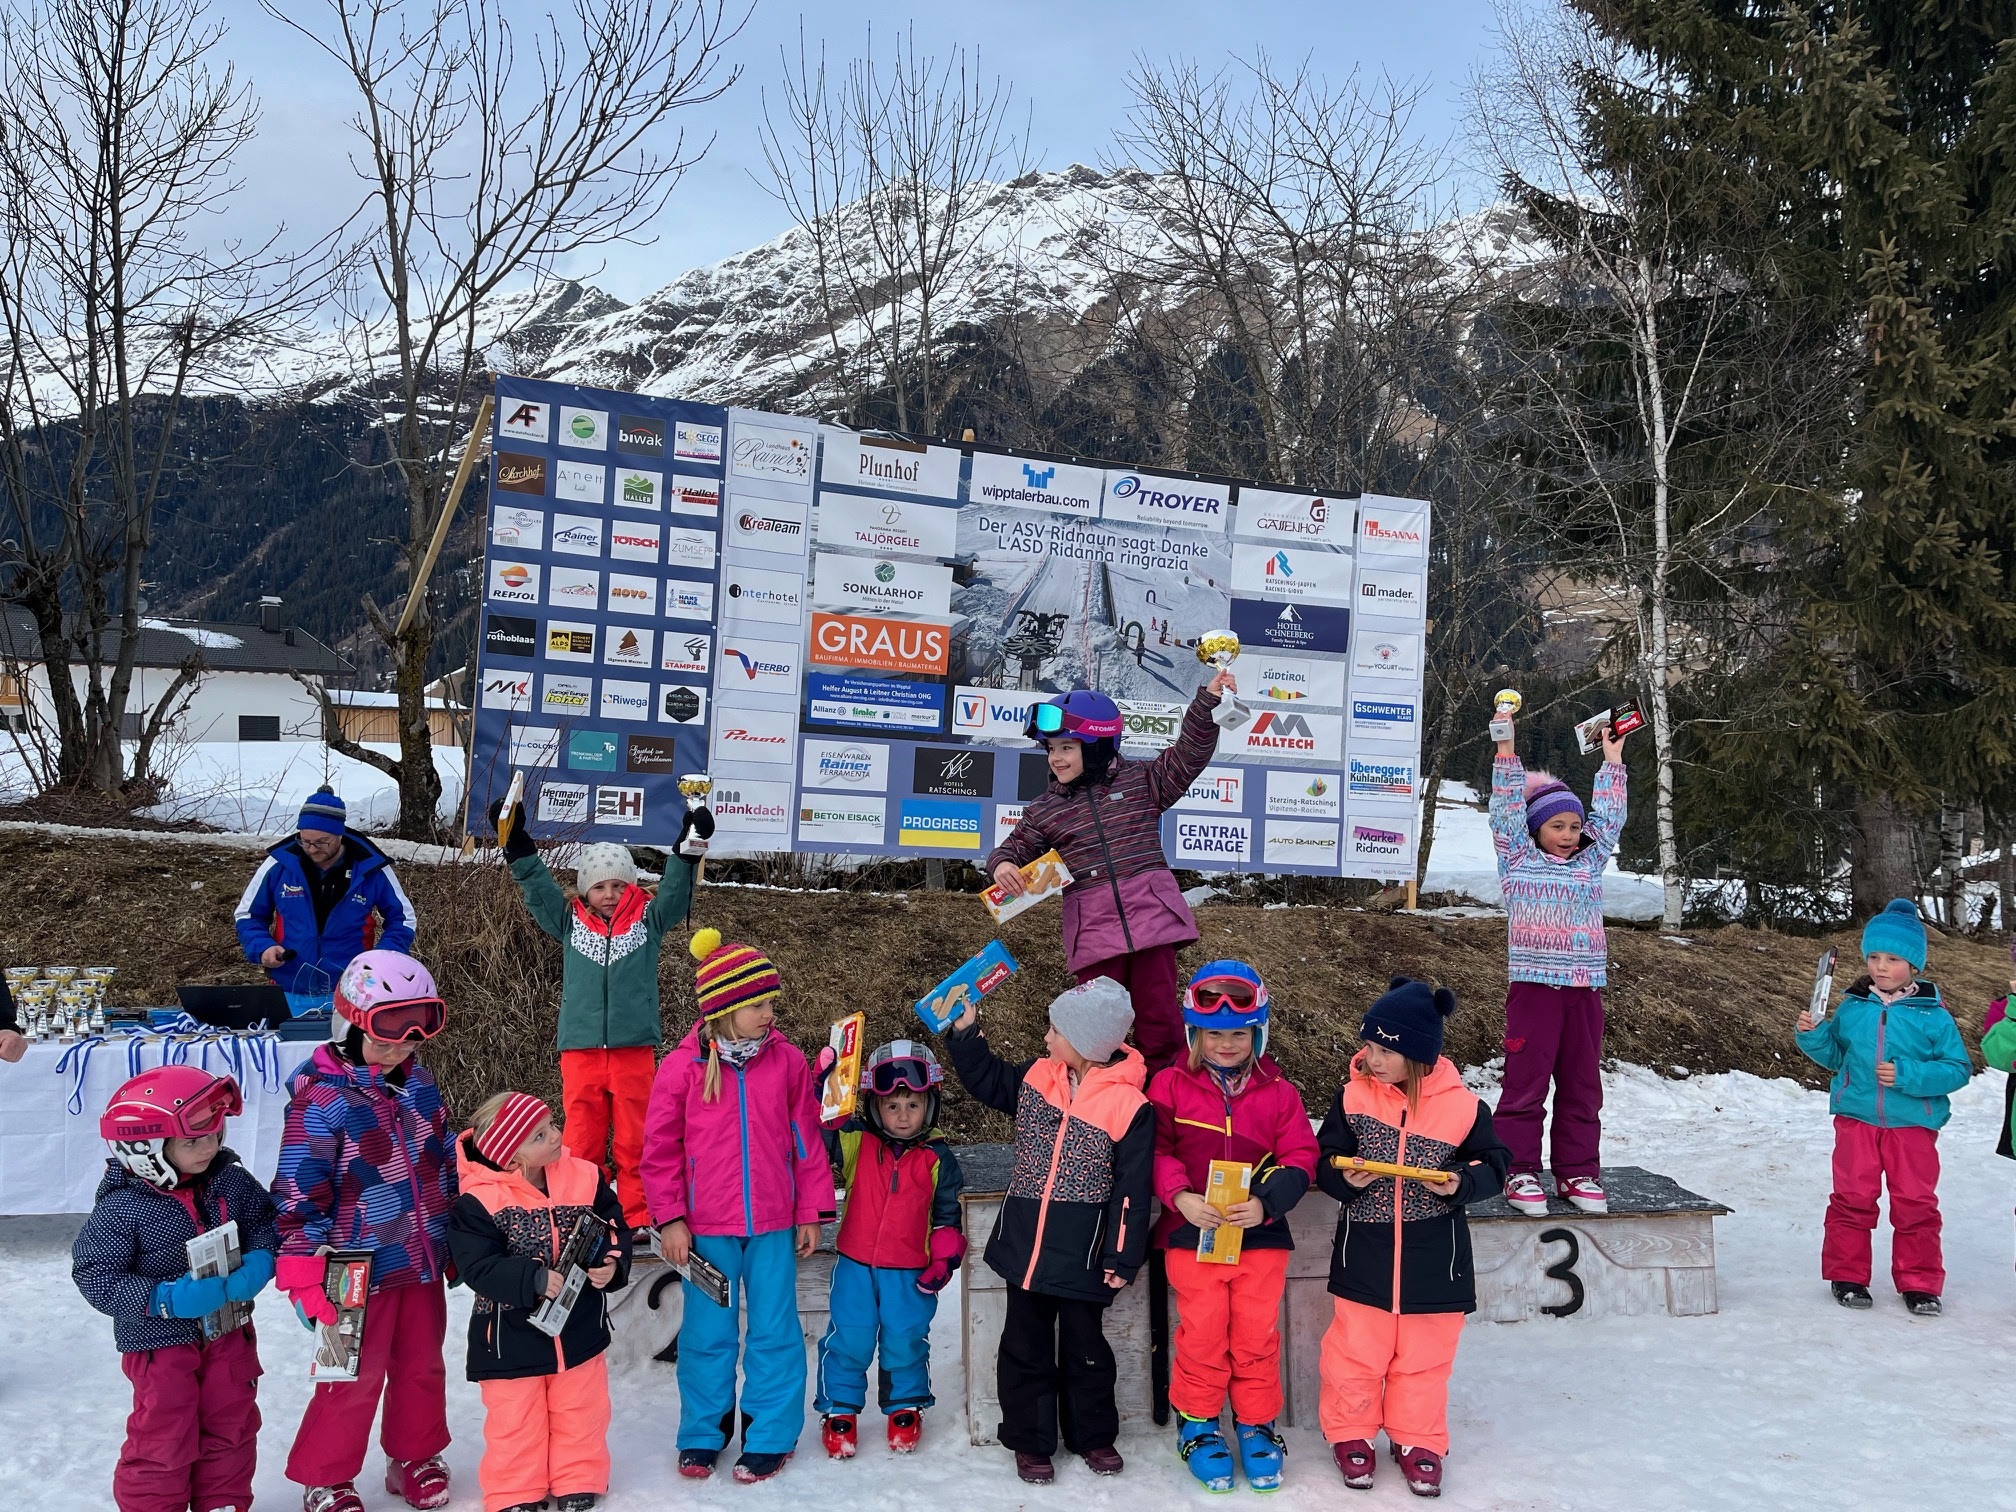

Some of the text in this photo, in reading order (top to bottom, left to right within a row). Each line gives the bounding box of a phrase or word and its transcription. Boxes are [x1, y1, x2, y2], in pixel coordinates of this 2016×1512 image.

[619, 429, 663, 447] biwak
[733, 438, 795, 468] Rainer
[765, 442, 791, 451] Landhaus
[859, 453, 920, 482] Plunhof
[857, 478, 874, 487] Heimat
[885, 482, 918, 493] Generationen
[625, 493, 651, 503] HALLER
[683, 487, 717, 498] Haller
[982, 484, 1090, 509] wipptalerbau.com
[1137, 489, 1220, 514] TROYER
[743, 515, 802, 535] KreaTeam
[1136, 514, 1181, 526] Reliability beyond
[1257, 517, 1326, 535] GASSENHOF
[564, 530, 598, 541] Rainer
[612, 535, 659, 548] TÖTSCH
[855, 531, 920, 548] TALJÖRGELE
[978, 517, 1209, 558] Der ASV Ridnaun sagt Danke
[671, 543, 713, 555] ZUMSEPP
[998, 535, 1189, 571] L'ASD Ridanna ringrazia
[493, 589, 536, 600] REPSOL
[729, 583, 799, 603] interhotel
[842, 582, 924, 600] SONKLARHOF
[1277, 621, 1303, 631] HOTEL
[487, 632, 535, 644] rothoblaas
[1264, 628, 1315, 640] SCHNEEBERG
[817, 620, 942, 662] GRAUS
[664, 661, 706, 671] STAMPFER
[814, 654, 849, 663] BAUFIRMA
[854, 657, 893, 667] IMMOBILIEN
[898, 661, 942, 671] BAUMATERIAL
[1373, 663, 1398, 671] YOGURT
[569, 690, 589, 698] Europa
[841, 687, 862, 695] August
[891, 690, 917, 698] Christian
[612, 694, 648, 708] Riwega
[813, 705, 836, 714] Allianz
[852, 706, 877, 716] tiroler
[1354, 702, 1412, 716] GSCHWENTER
[1121, 714, 1178, 735] FORST
[722, 729, 787, 744] Prinoth
[1247, 735, 1314, 750] MALTECH
[628, 744, 654, 757] Gasthof
[820, 751, 872, 761] EISENWAREN
[1246, 747, 1273, 755] efficiency
[819, 758, 872, 772] Rainer
[1350, 759, 1406, 777] Überegger
[819, 768, 871, 778] FERRAMENTA
[1350, 772, 1406, 786] Kühlanlagen
[543, 788, 585, 799] Hermann
[929, 786, 977, 796] RATSCHINGS
[548, 797, 577, 807] Thaler
[597, 790, 642, 816] EH
[1269, 796, 1337, 807] Sterzing-Ratschings
[715, 802, 785, 816] plankdach
[1269, 804, 1327, 814] Vipiteno-Racines
[813, 812, 881, 823] BETON EISACK
[903, 815, 978, 831] PROGRESS
[1179, 823, 1248, 840] CENTRAL
[1360, 831, 1397, 843] Market
[1182, 838, 1244, 853] GARAGE
[1268, 837, 1336, 847] AUTO RAINER
[1356, 843, 1399, 854] Ridnaun
[1540, 1228, 1585, 1318] 3
[352, 1265, 366, 1304] Loacker
